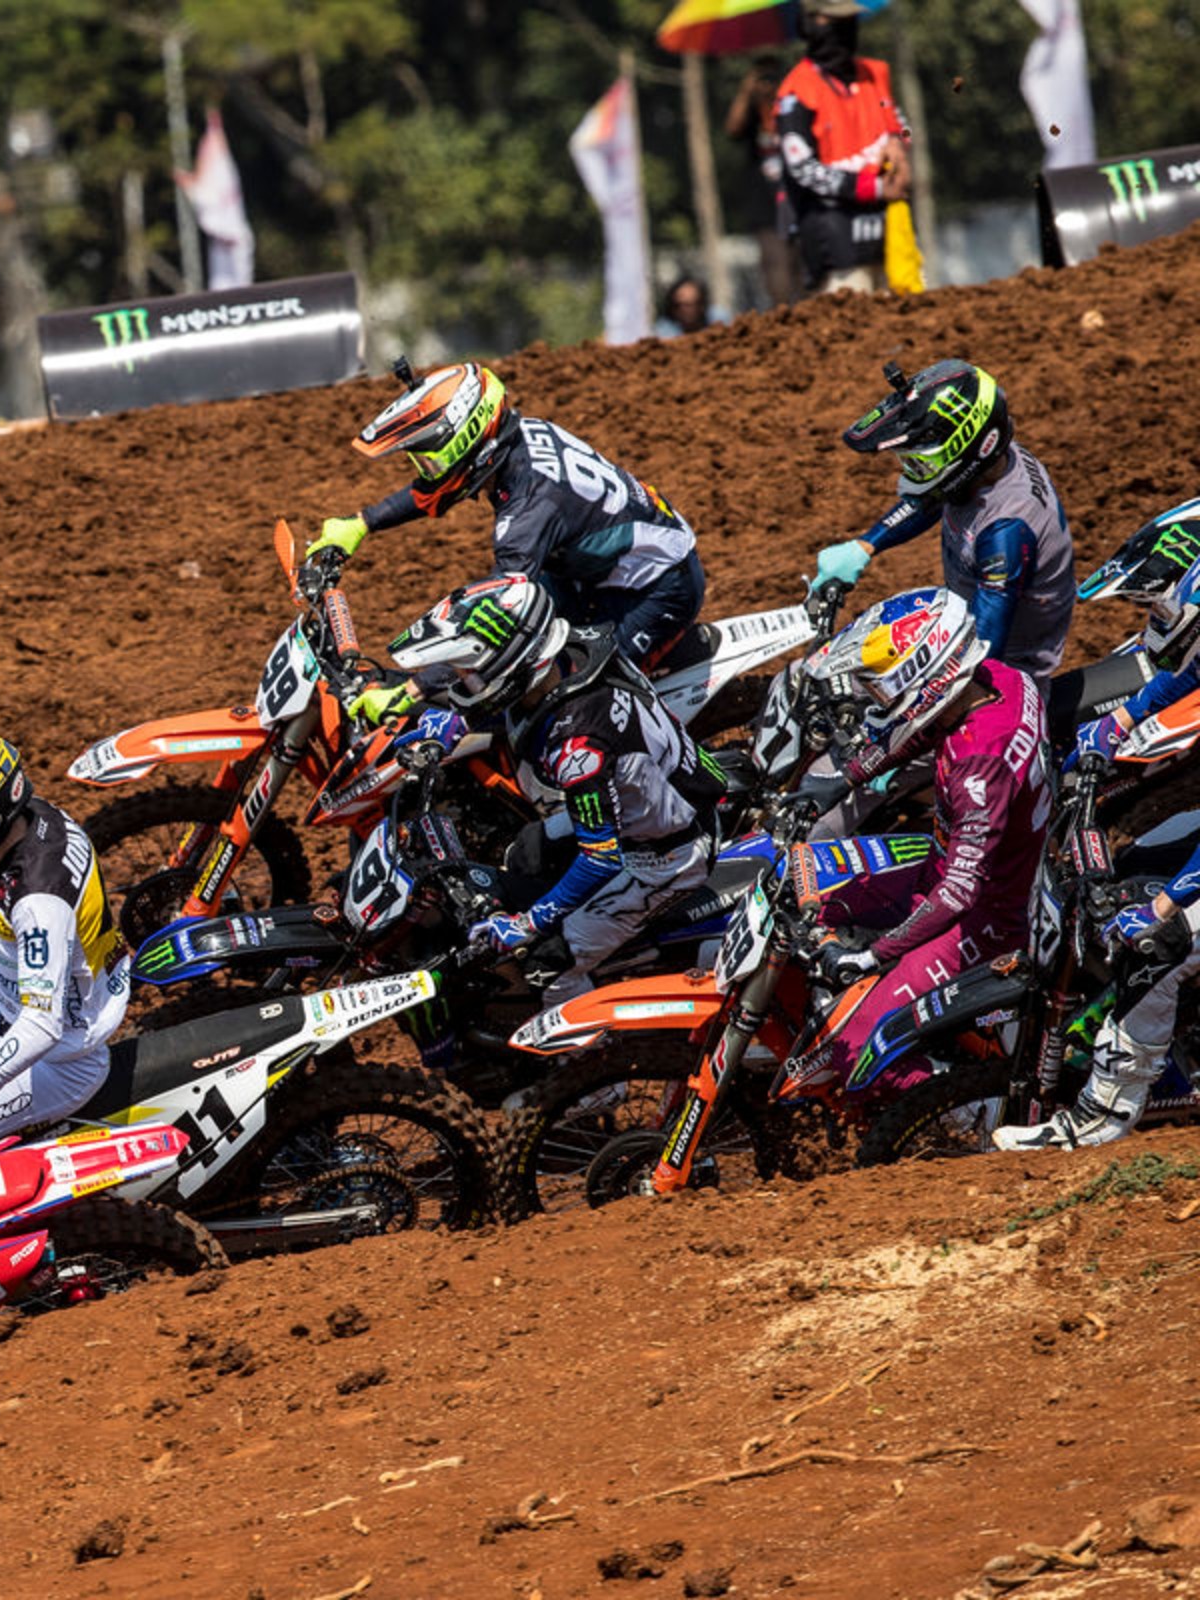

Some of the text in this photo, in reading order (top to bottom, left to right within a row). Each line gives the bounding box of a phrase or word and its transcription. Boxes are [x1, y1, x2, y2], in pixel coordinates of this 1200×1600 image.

[261, 641, 300, 719] 99
[892, 623, 950, 692] 100%
[903, 656, 962, 721] Red Bull
[203, 843, 234, 900] DUNLOP
[688, 893, 735, 921] YAMAHA
[346, 991, 419, 1028] DUNLOP
[169, 1086, 244, 1170] 41
[672, 1098, 701, 1166] DUNLOP
